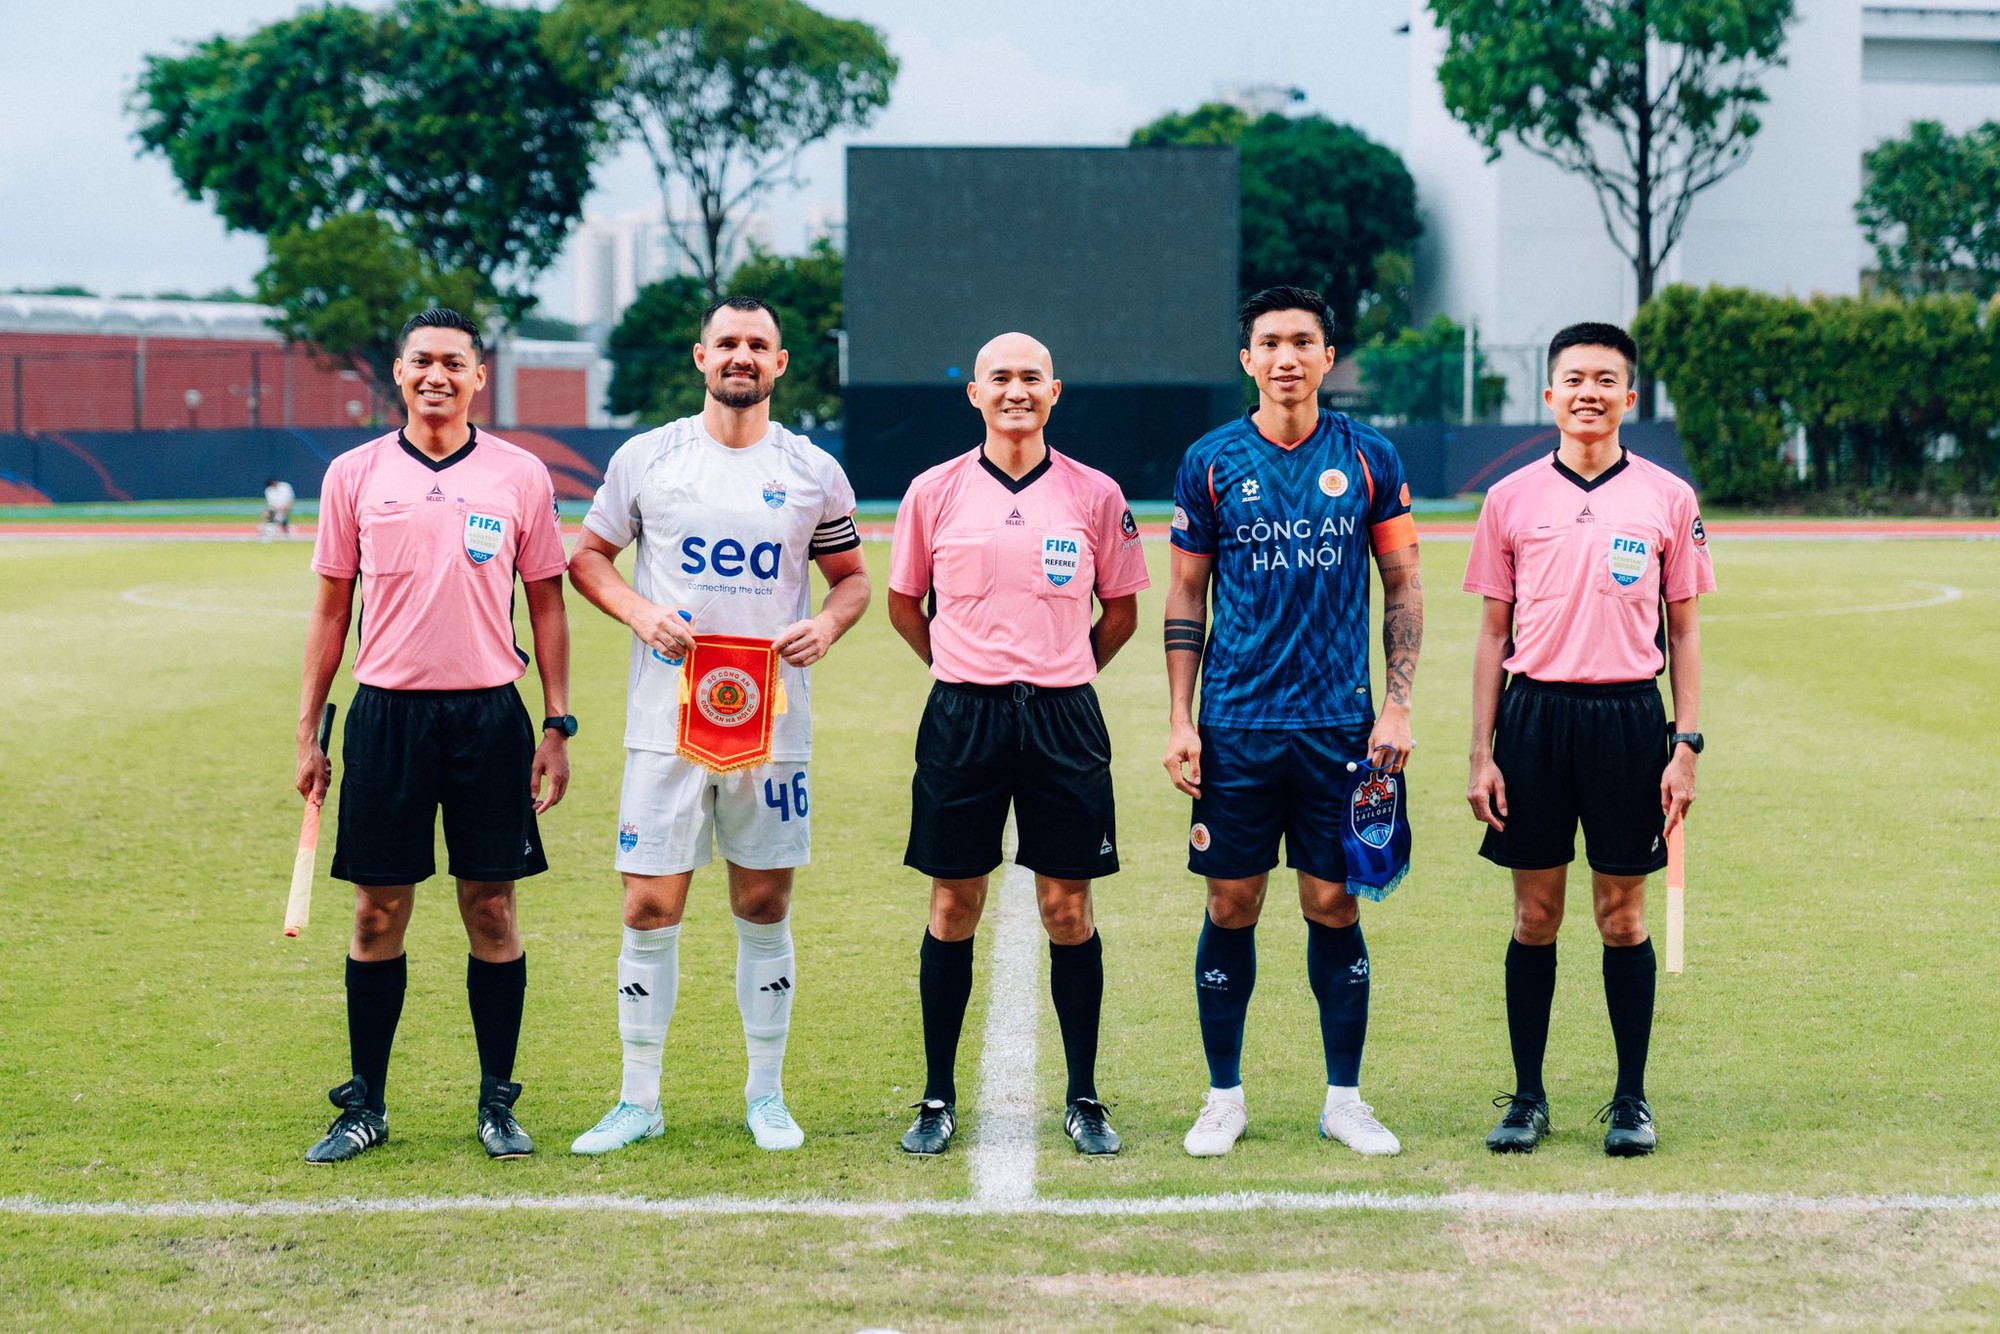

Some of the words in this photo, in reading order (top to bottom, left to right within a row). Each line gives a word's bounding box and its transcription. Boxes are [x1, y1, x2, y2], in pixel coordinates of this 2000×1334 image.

[469, 515, 502, 533] FIFA
[1236, 517, 1311, 544] CÔNG
[1320, 516, 1356, 537] AN
[1046, 539, 1077, 554] FIFA
[1614, 538, 1646, 555] FIFA
[472, 552, 488, 560] 2025
[681, 536, 782, 580] sea
[1045, 558, 1076, 568] REFEREE
[1252, 546, 1290, 572] HÀ
[1297, 542, 1342, 572] NỘI
[1618, 574, 1632, 582] 2025
[688, 582, 736, 595] connecting
[739, 586, 752, 594] the
[764, 771, 808, 822] 46
[1356, 806, 1392, 822] SAILORS
